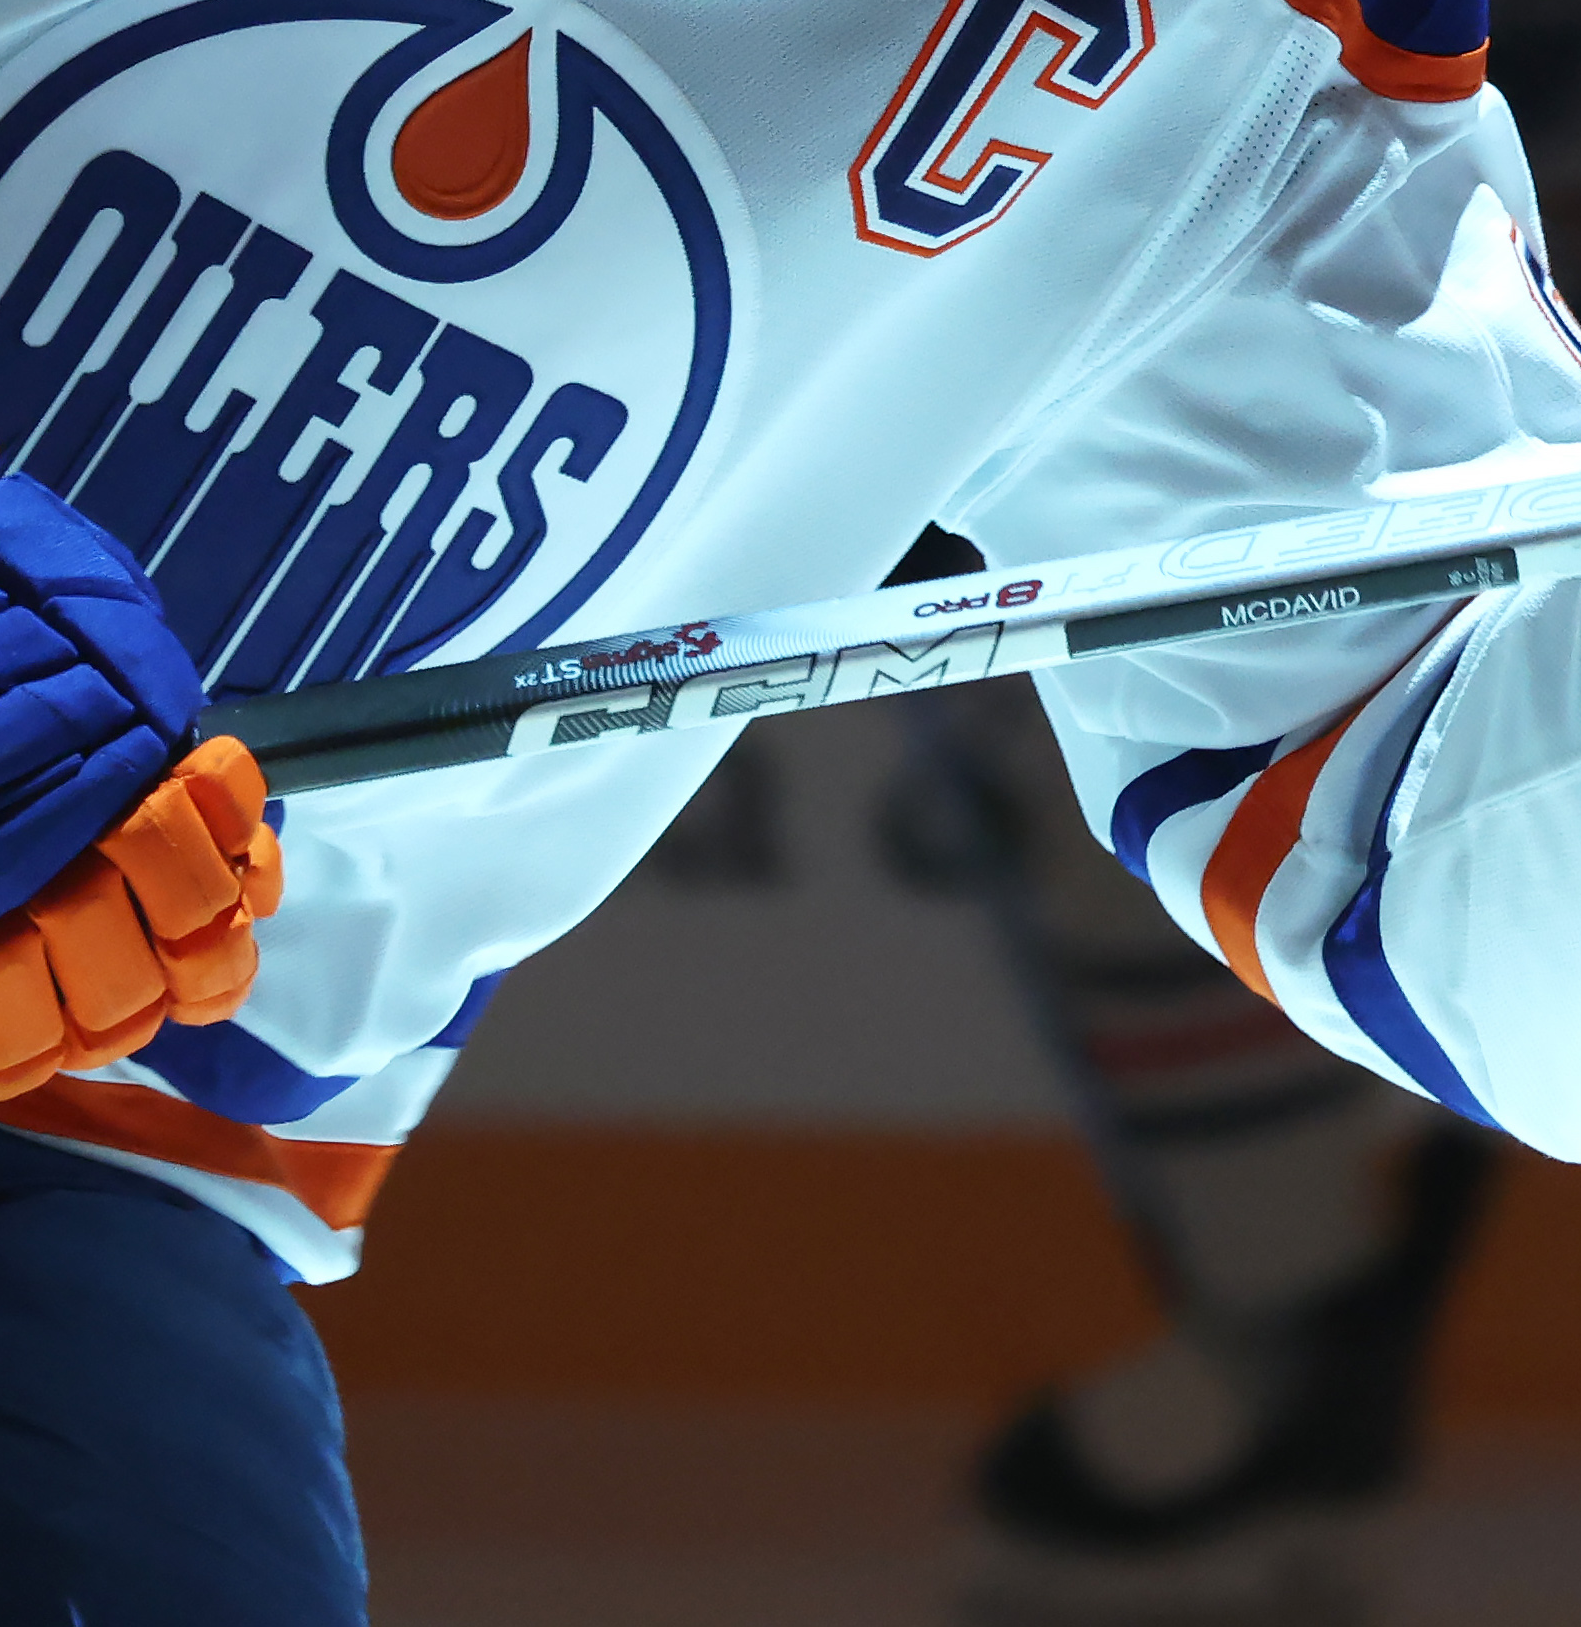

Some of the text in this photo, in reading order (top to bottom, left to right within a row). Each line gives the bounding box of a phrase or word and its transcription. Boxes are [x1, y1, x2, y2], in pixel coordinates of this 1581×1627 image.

[913, 592, 992, 618] PRO
[1220, 585, 1361, 629] MCDAVID
[506, 621, 1005, 757] CCM
